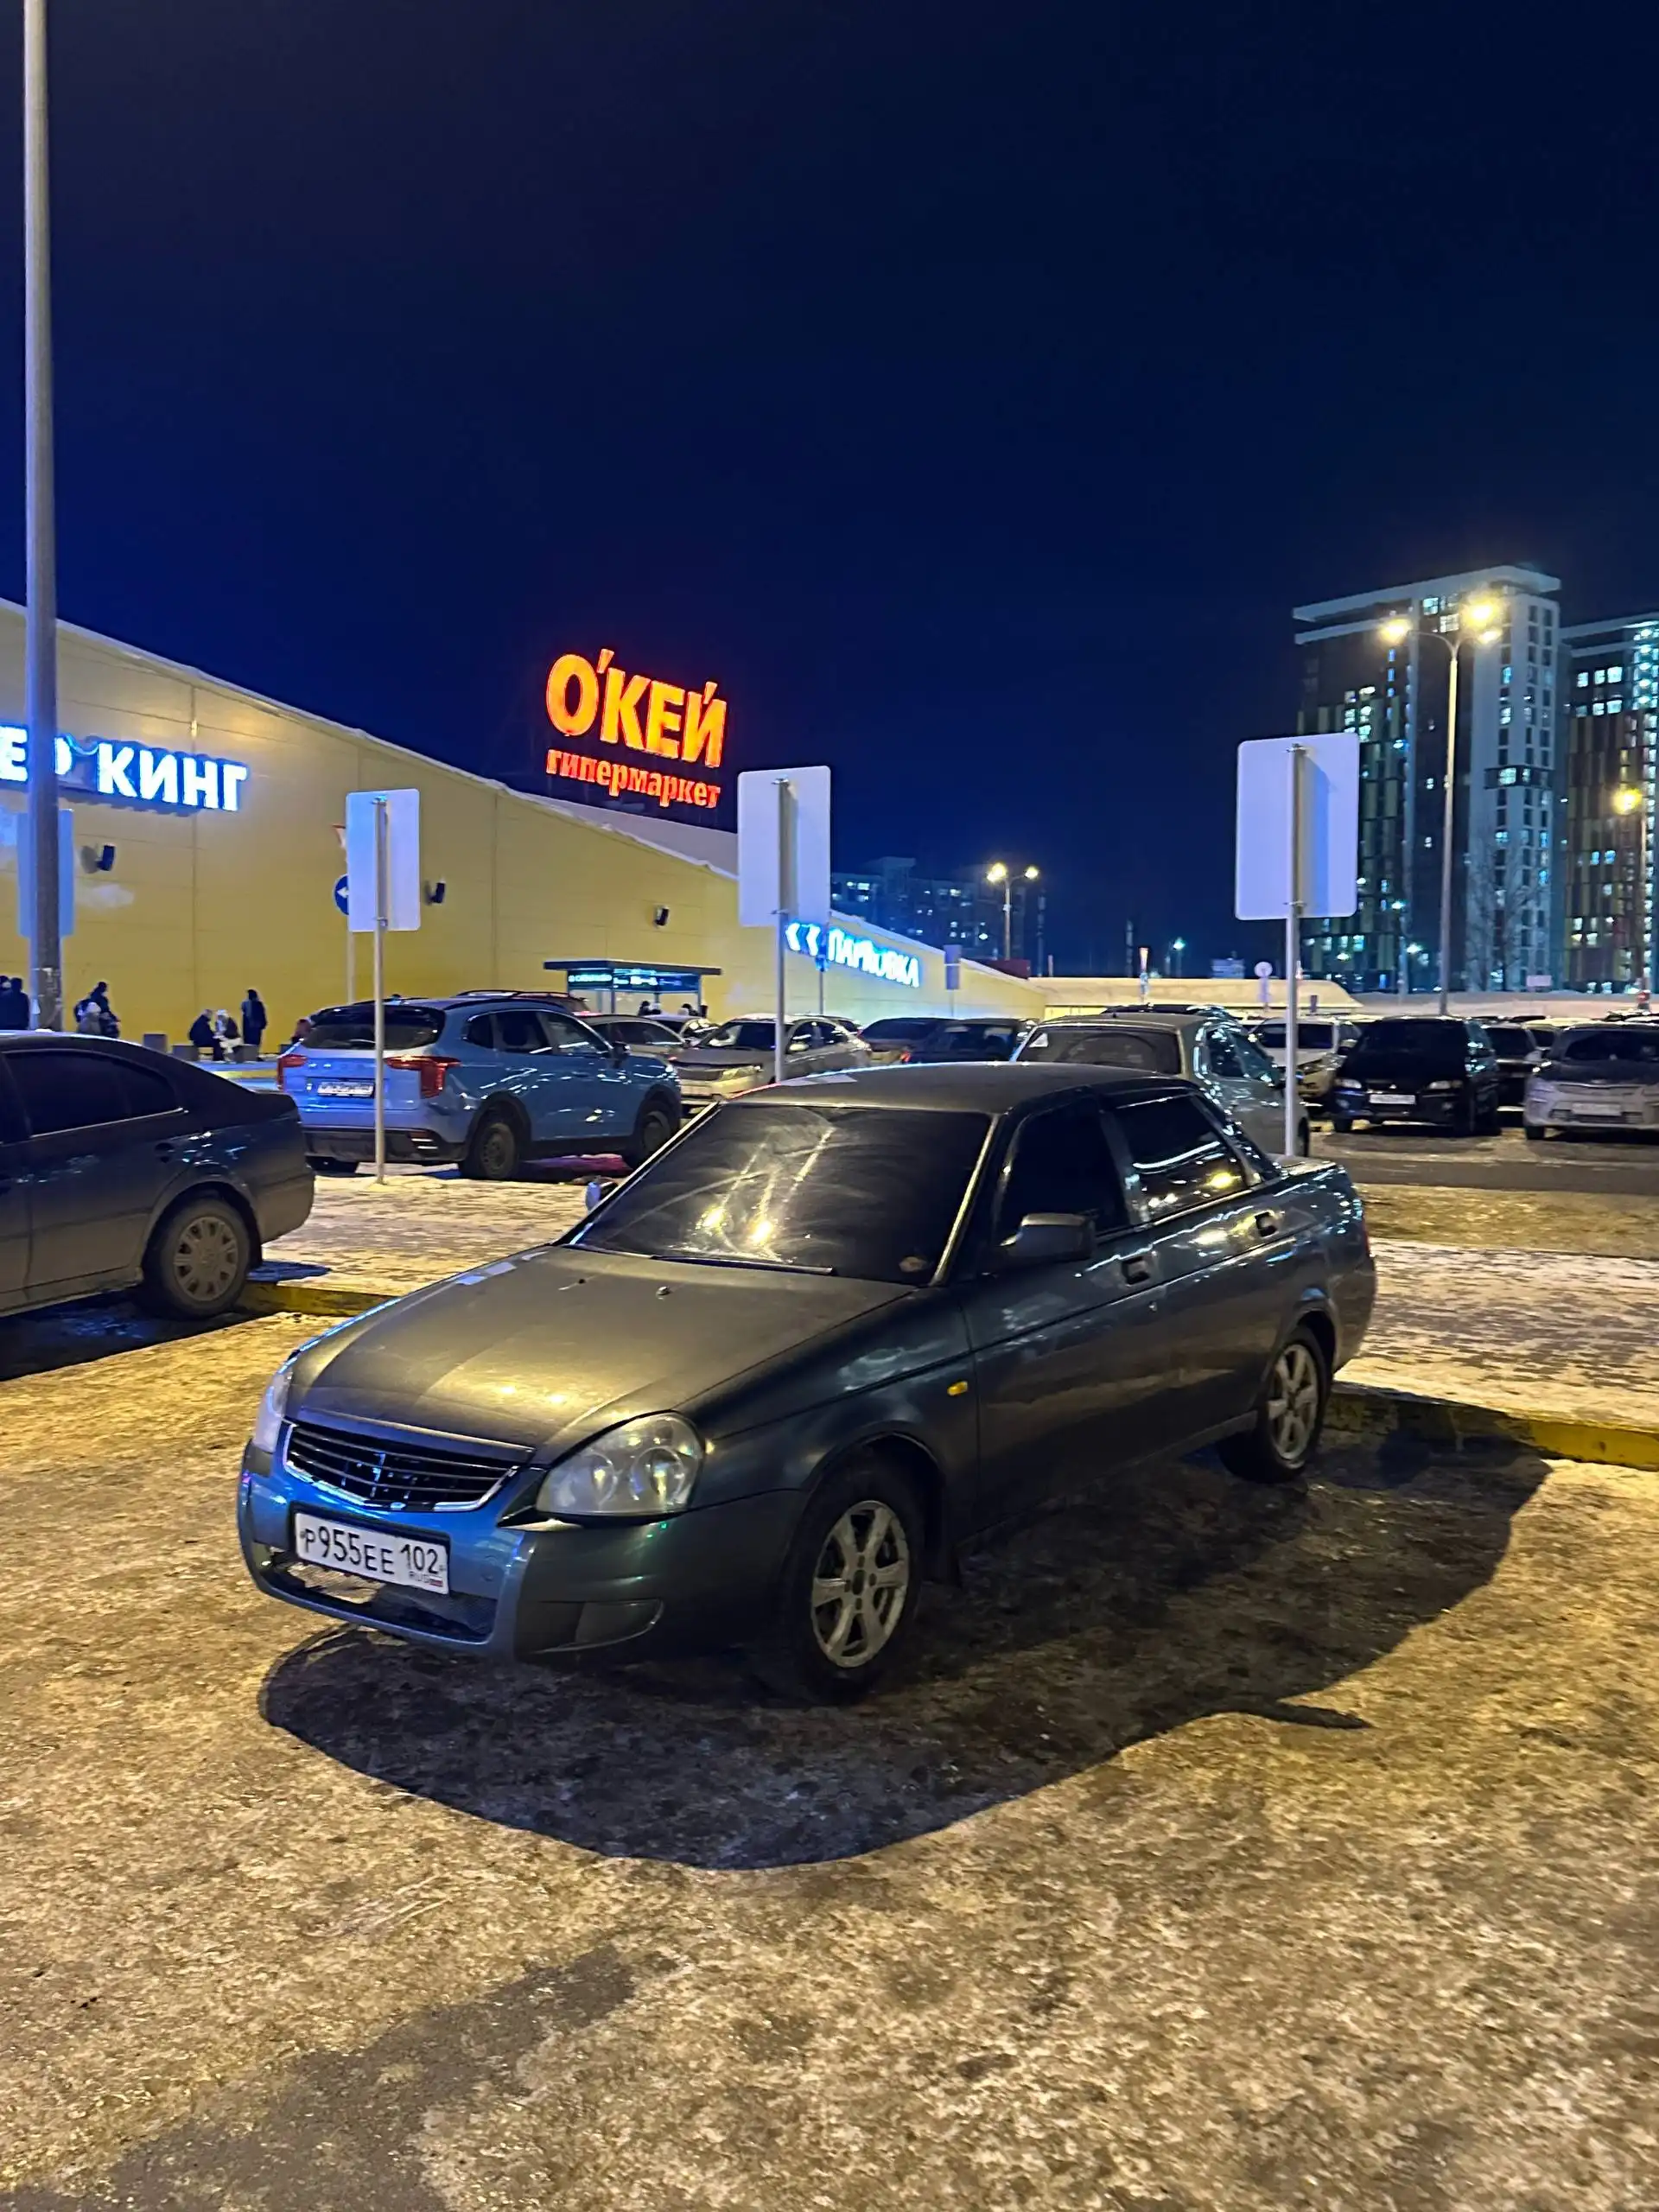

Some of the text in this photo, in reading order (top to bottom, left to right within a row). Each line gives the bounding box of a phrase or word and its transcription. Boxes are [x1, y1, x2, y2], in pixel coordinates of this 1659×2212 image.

[99, 743, 247, 810] КИНГ
[546, 750, 721, 808] гипермаркет
[400, 1544, 439, 1574] 102
